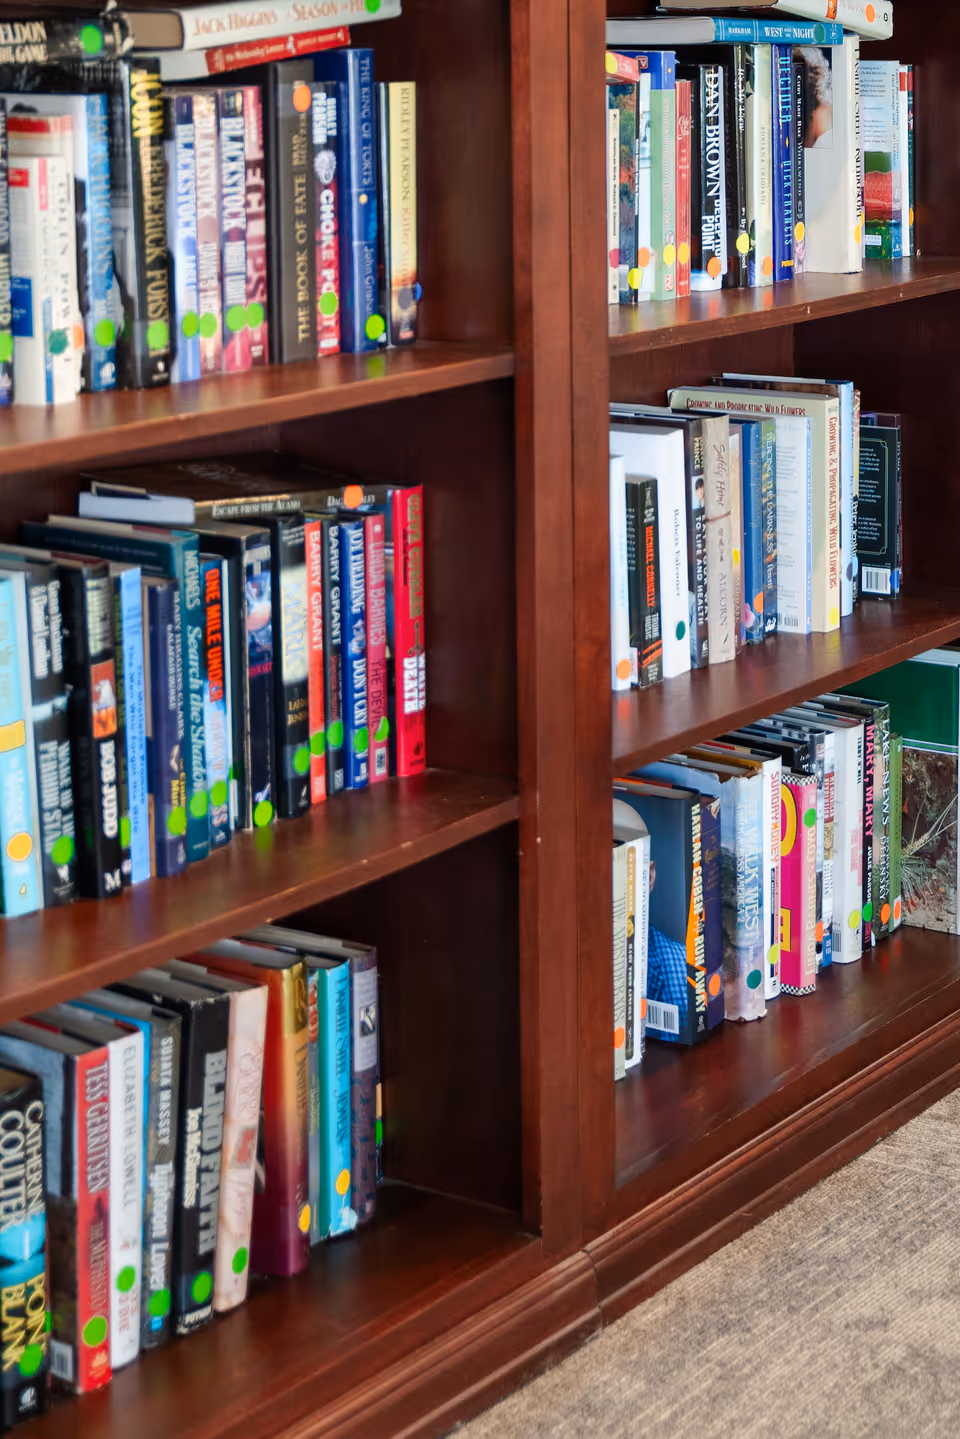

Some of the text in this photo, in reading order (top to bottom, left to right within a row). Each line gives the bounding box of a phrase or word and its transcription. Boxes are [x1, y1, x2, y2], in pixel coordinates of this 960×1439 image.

[16, 44, 48, 65] GAME
[193, 16, 229, 37] JACK
[228, 9, 279, 32] HIGGINS
[728, 25, 814, 39] MARKHAM WEST NIGHT
[313, 91, 327, 145] PEARSON
[325, 97, 336, 136] RIDLEY
[360, 56, 373, 186] THE KING OF TORTS
[705, 71, 720, 197] DAN BROWN
[780, 56, 794, 246] DECIDER DICK FRANCIS
[293, 174, 311, 343] THE BOOK OF FATE
[701, 215, 716, 252] POINT
[693, 436, 701, 469] PRINCE
[713, 442, 728, 506] Safely Home
[695, 514, 703, 529] TO
[695, 532, 703, 554] LIFE
[827, 416, 839, 590] GROWING & PROPAGATING WILD FLOWERS
[184, 550, 200, 610] MICHAELS
[309, 529, 323, 651] BARRY GRANT
[329, 524, 342, 645] BARRY GRANT
[645, 525, 656, 608] MICHAEL CONNELLY
[673, 508, 682, 597] Robert Falconer
[47, 579, 64, 674] Gene Hackman
[205, 567, 224, 702] ONE MILE UNDER
[349, 526, 368, 727] JOY FIELDING DON'T CRY
[651, 613, 660, 638] TRUNK
[696, 583, 704, 625] HEALTH
[718, 571, 729, 626] ALCORN
[403, 656, 417, 714] DEATH
[100, 740, 118, 837] BOB JUDD
[881, 718, 890, 826] LAKE NEWS
[770, 773, 781, 863] SUNDAY MONEY
[691, 802, 706, 1012] HARLAN COBEN RUN AWAY
[122, 1045, 137, 1209] ELIZABETH LOWELL
[159, 1036, 174, 1145] SUJATA MASSEY
[0, 1110, 26, 1233] COULTER
[26, 1100, 45, 1219] CATHERINE
[86, 1061, 110, 1311] TESS GERRITSEN MEPHISTO
[2, 1285, 26, 1372] BLANK
